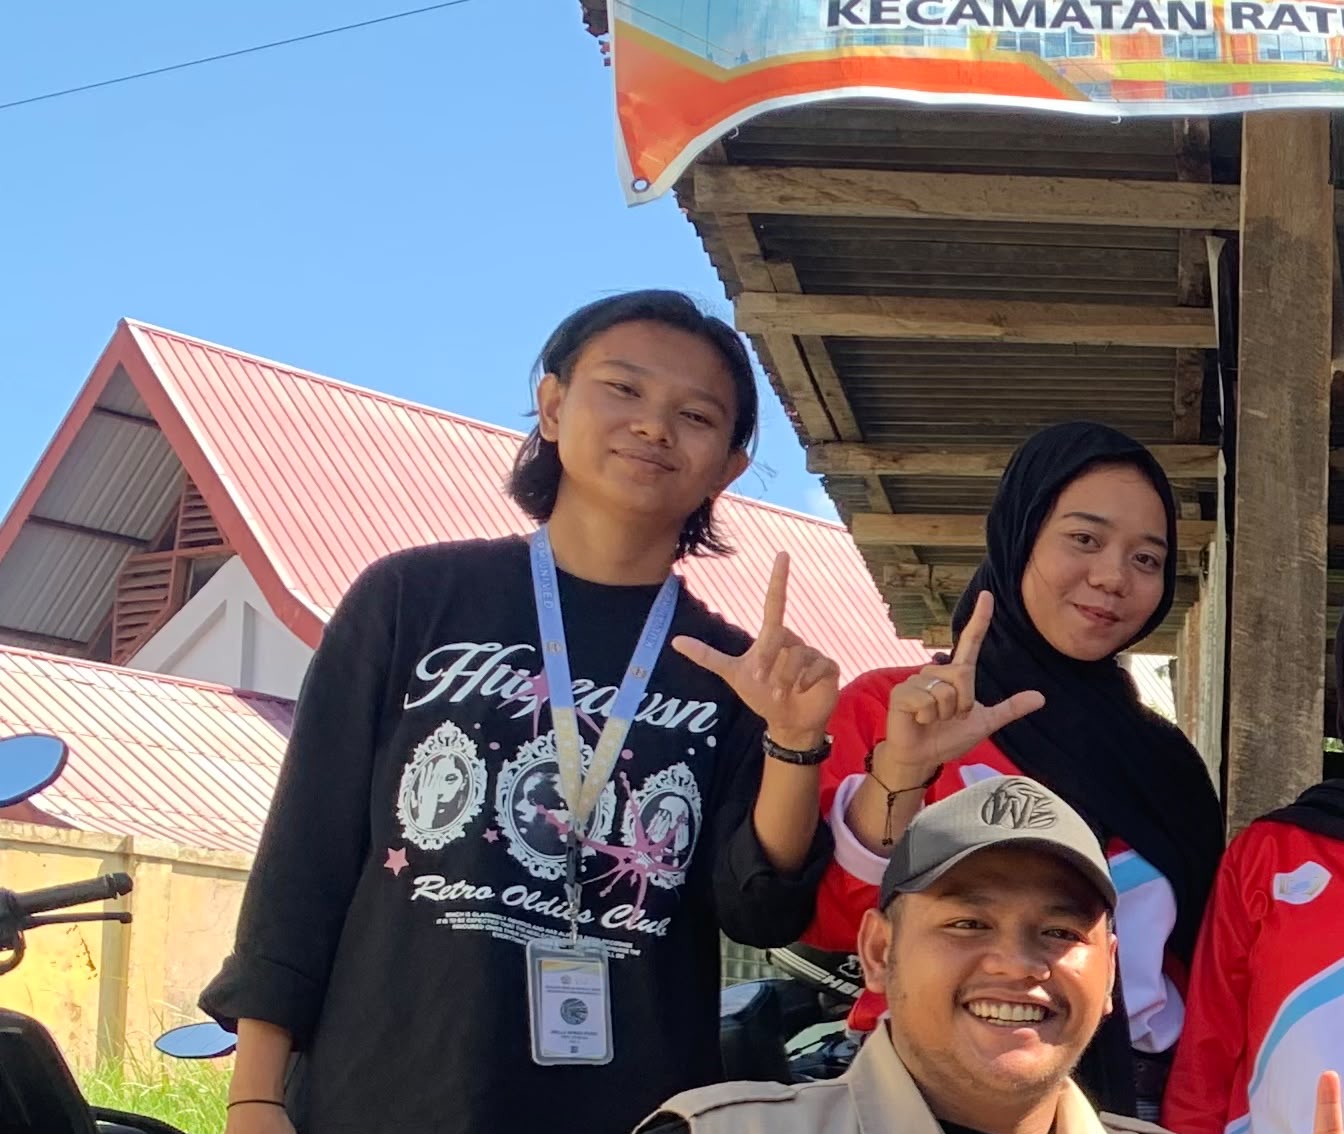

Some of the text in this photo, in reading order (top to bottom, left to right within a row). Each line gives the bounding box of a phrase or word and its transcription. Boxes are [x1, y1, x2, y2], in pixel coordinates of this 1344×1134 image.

[827, 0, 1207, 30] KECAMATAN
[411, 875, 672, 937] Retro Oldies Club
